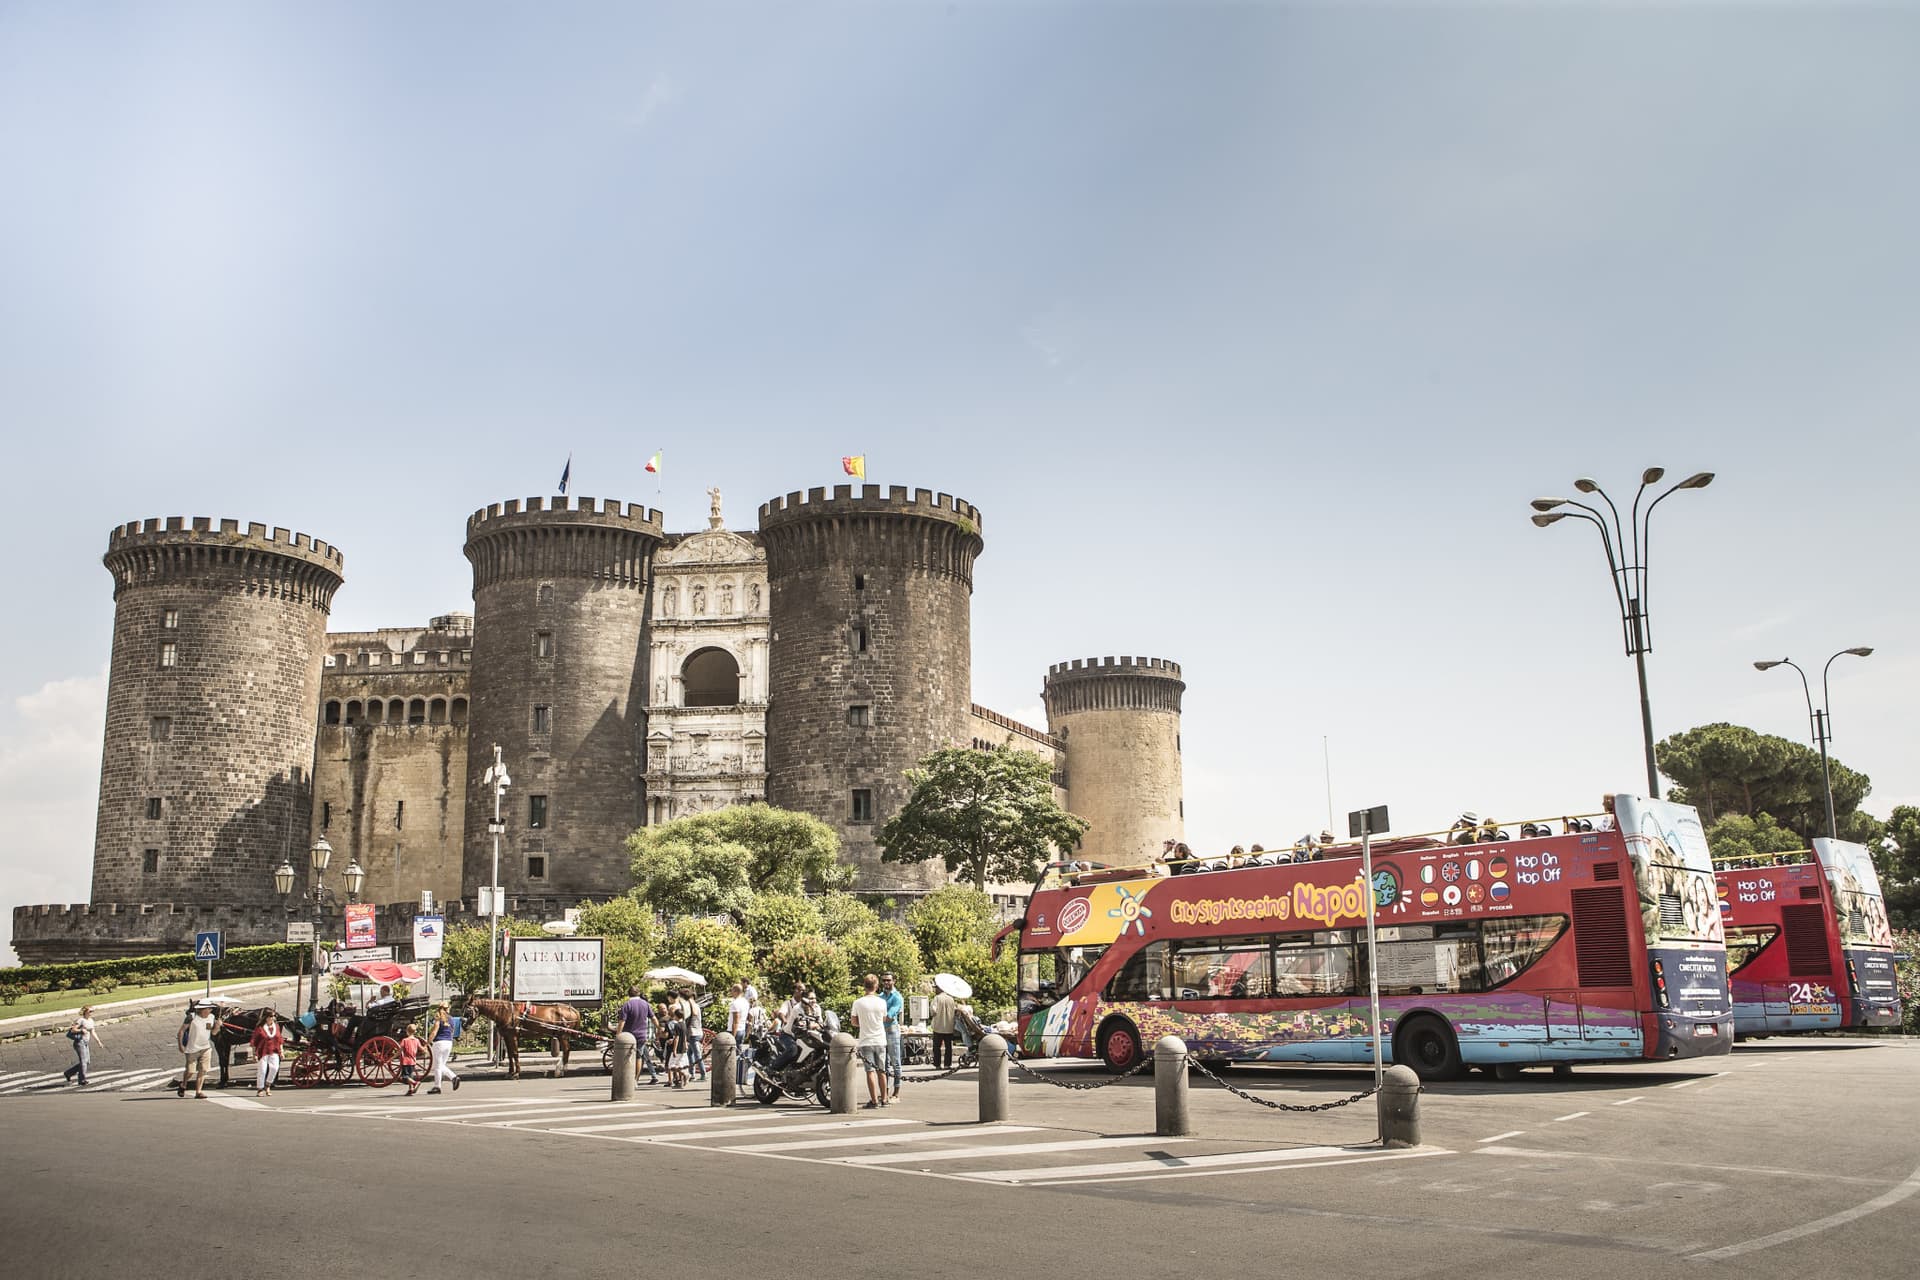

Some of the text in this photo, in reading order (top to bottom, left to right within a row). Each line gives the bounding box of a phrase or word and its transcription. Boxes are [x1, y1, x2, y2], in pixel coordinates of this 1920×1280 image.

[1515, 852, 1557, 868] Hop On
[1517, 868, 1561, 885] Hop Off
[1738, 878, 1773, 891] Hop On
[1294, 879, 1374, 926] Napol
[1739, 890, 1776, 903] Hop Off
[519, 951, 528, 962] A
